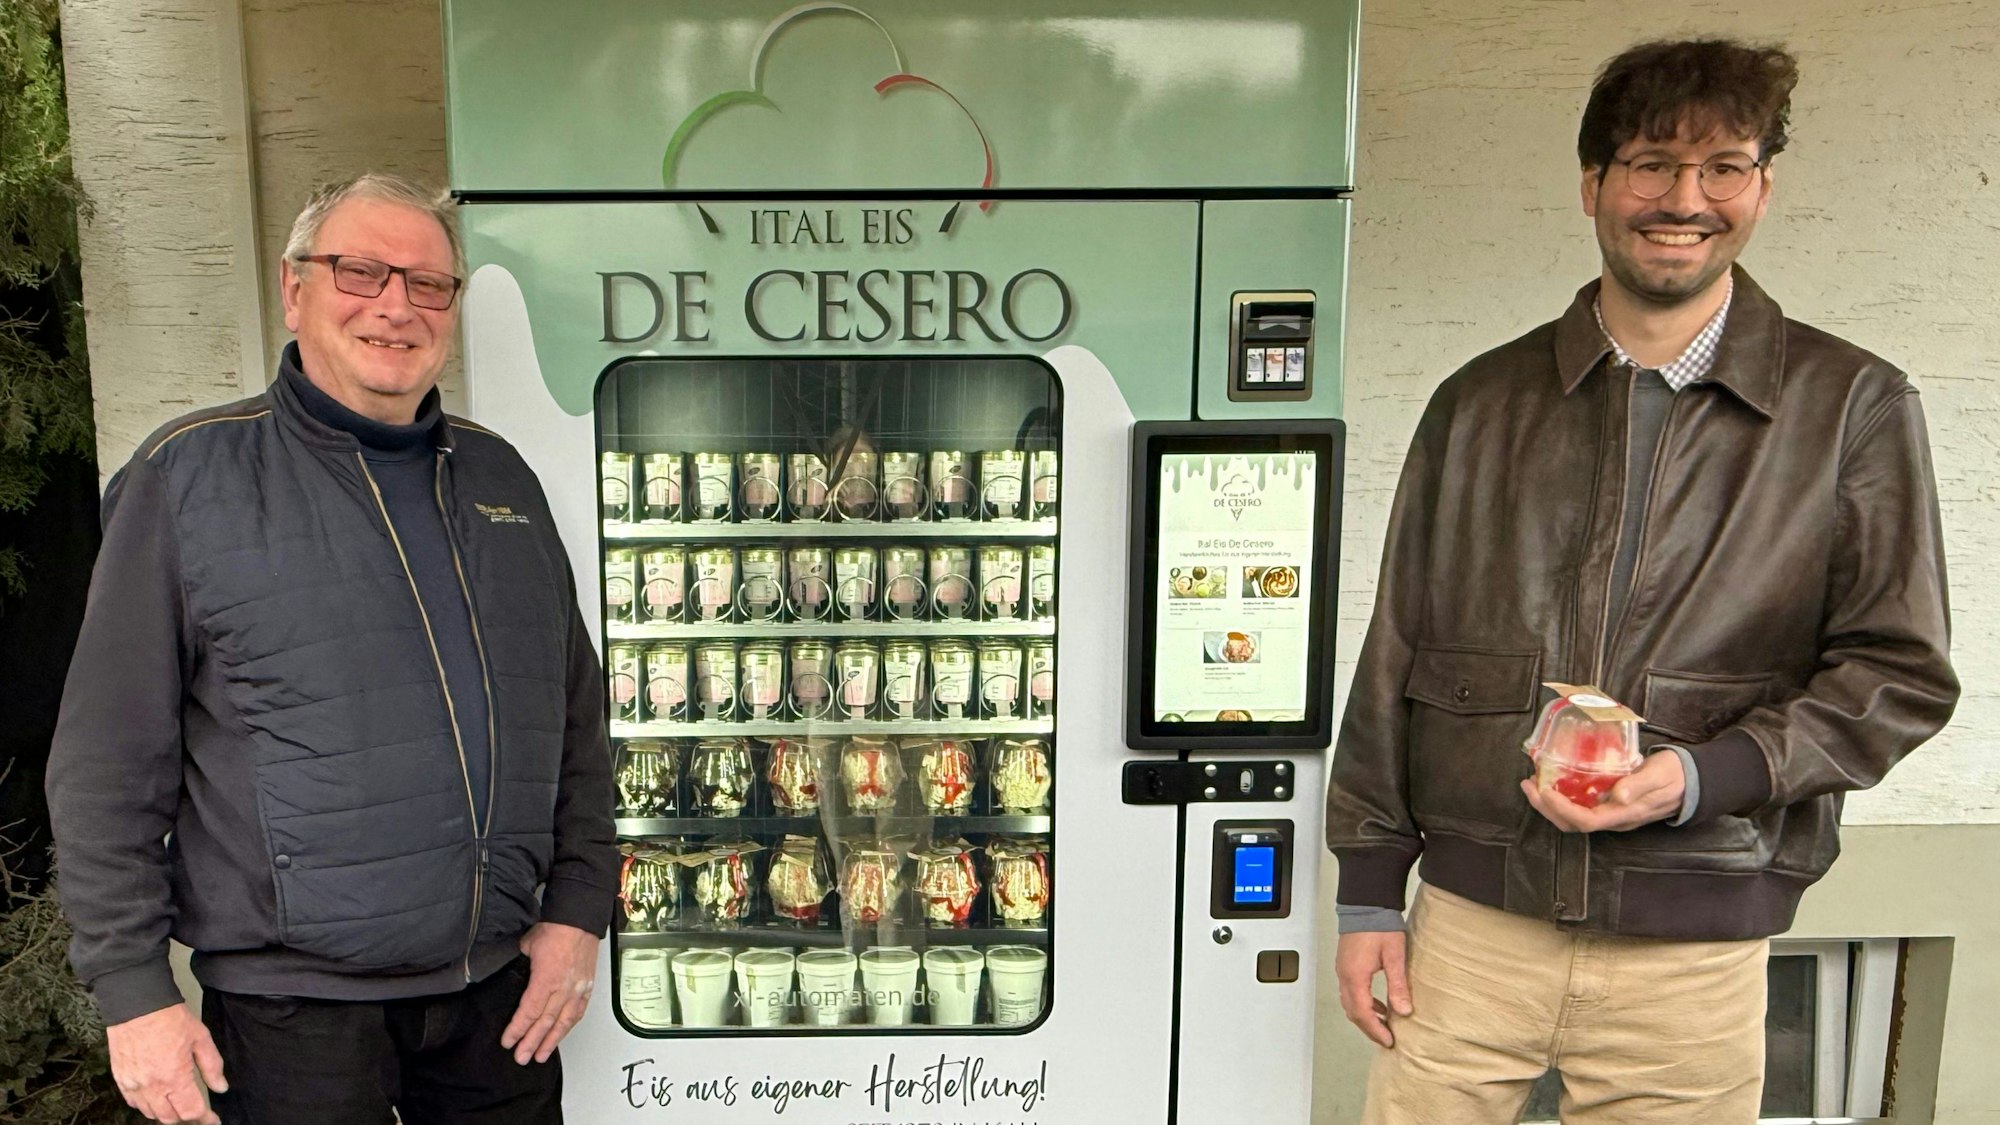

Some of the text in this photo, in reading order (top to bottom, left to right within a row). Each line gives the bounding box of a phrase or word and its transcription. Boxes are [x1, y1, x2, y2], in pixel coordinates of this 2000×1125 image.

[750, 209, 912, 245] ITAL EIS
[596, 268, 1072, 343] DE CESERO
[621, 1053, 1047, 1114] Eis aus eigener Herstellung!
